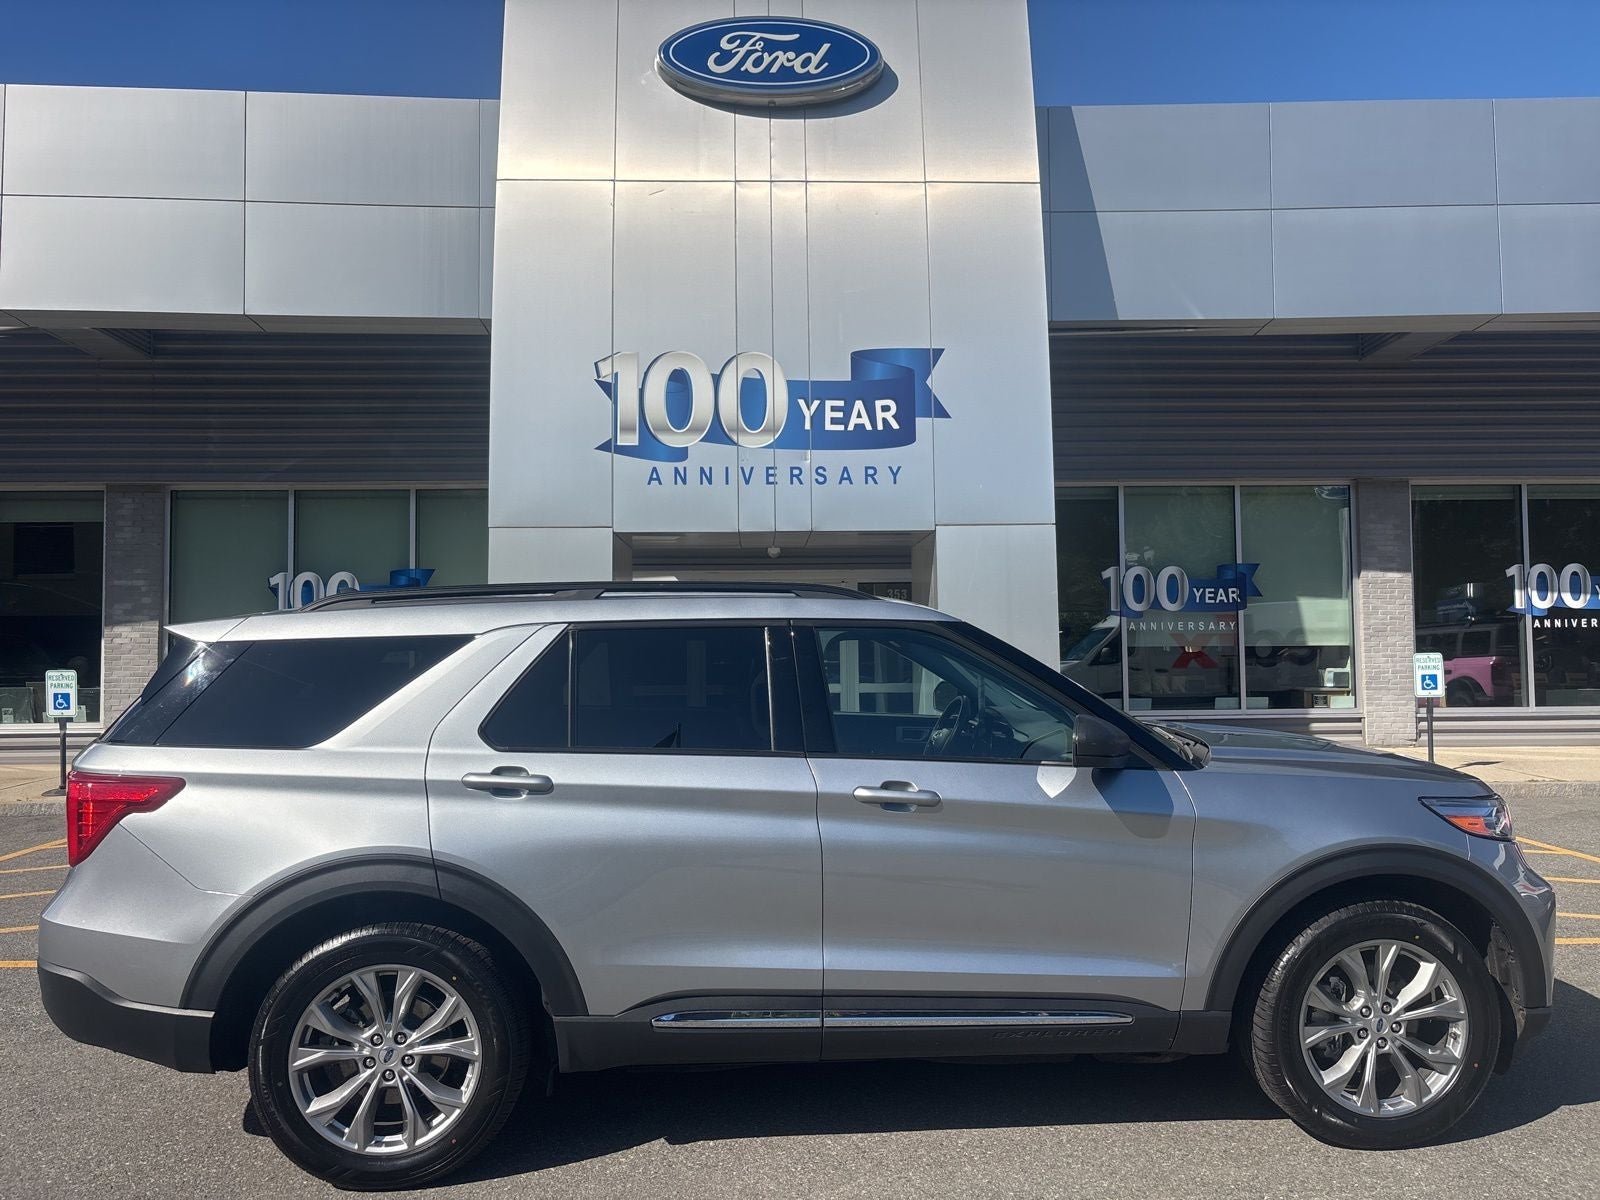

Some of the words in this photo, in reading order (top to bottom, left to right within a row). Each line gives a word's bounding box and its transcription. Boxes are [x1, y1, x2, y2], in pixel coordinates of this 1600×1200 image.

[707, 31, 832, 75] Ford
[594, 350, 789, 448] 100
[797, 398, 901, 431] YEAR
[647, 465, 902, 486] ANNIVERSARY
[1100, 565, 1190, 612] 100
[1192, 587, 1241, 604] YEAR
[1504, 563, 1592, 609] 100
[1128, 621, 1236, 631] ANNIVERSARY
